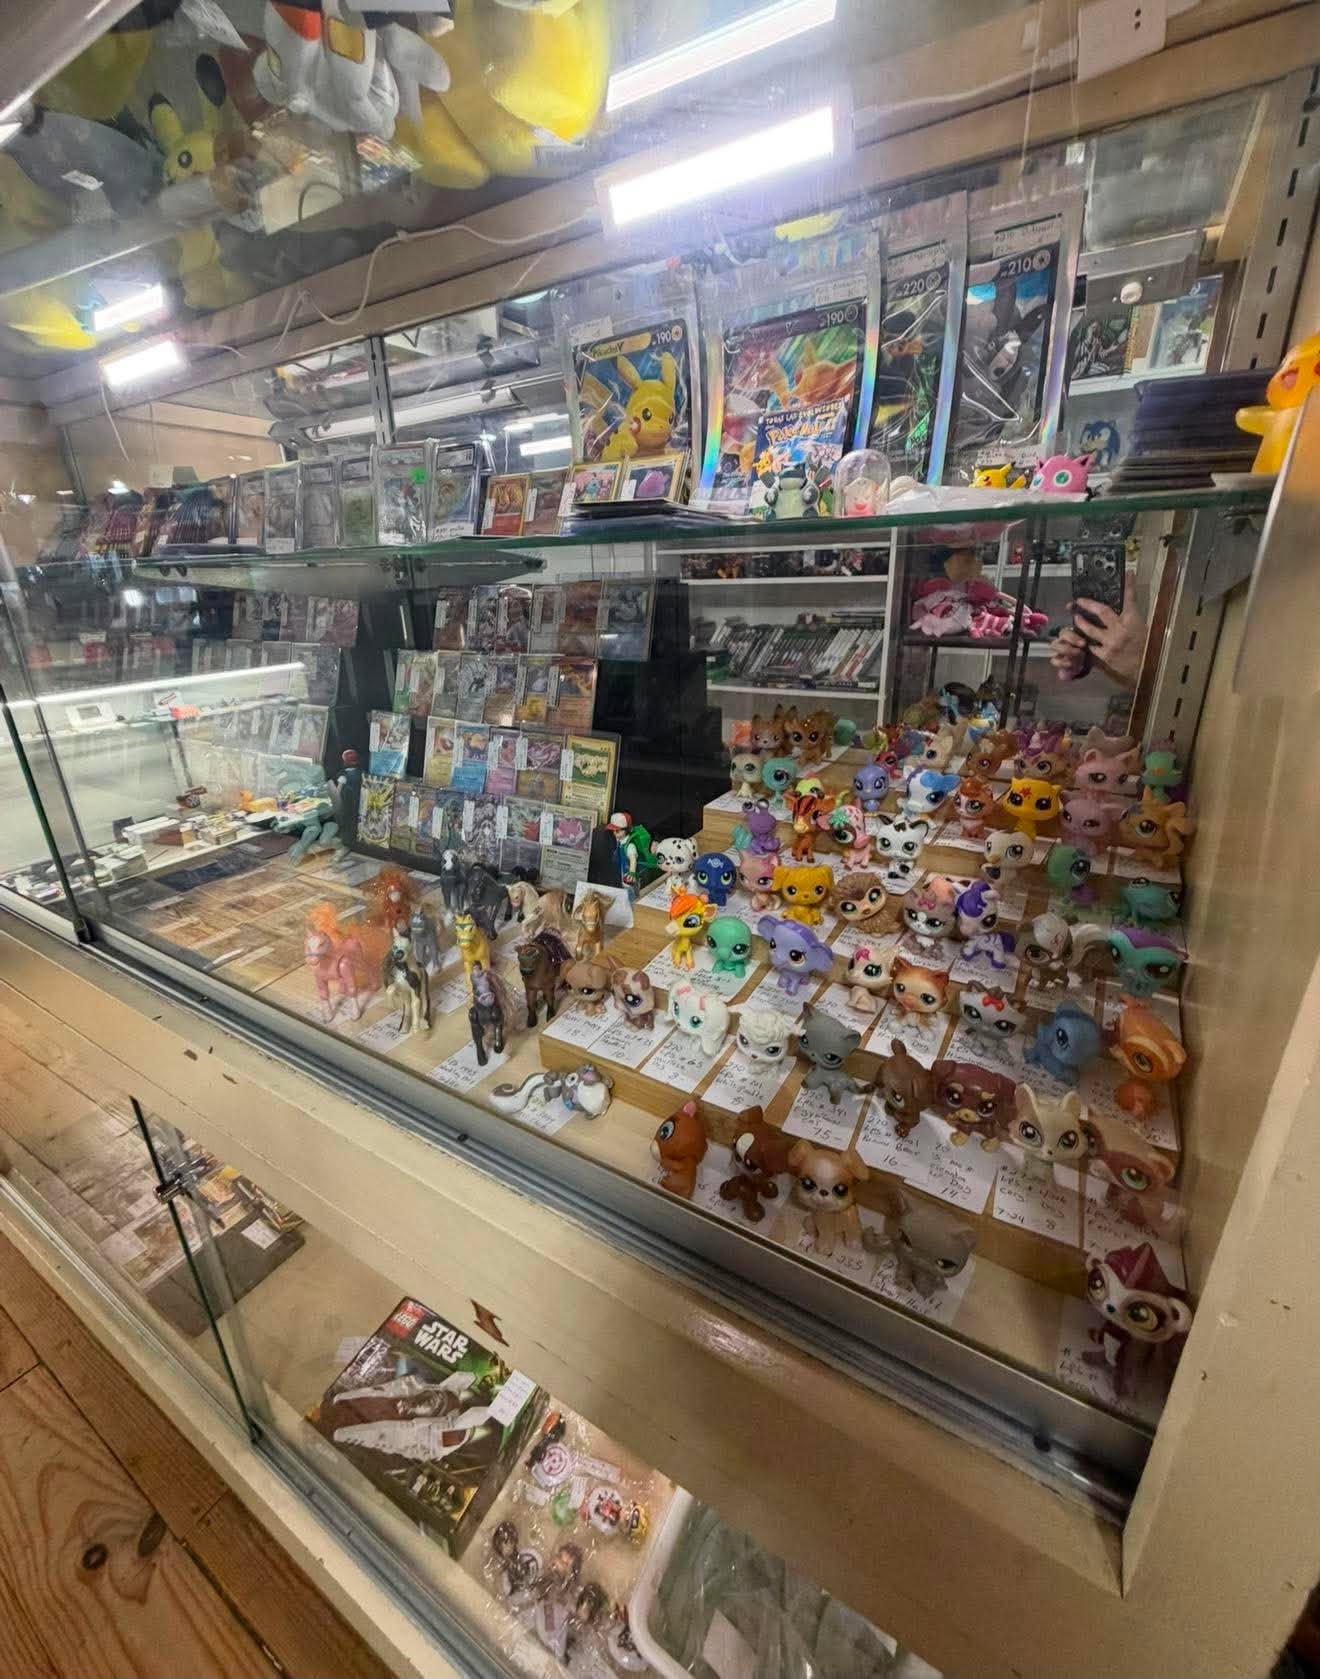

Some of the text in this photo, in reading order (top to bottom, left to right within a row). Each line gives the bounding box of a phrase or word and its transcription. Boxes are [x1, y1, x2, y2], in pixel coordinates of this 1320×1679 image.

[1009, 257, 1032, 275] 210
[903, 278, 925, 296] 220
[826, 310, 845, 327] 190
[656, 330, 672, 345] 190
[393, 1311, 417, 1329] LEGO
[423, 1321, 469, 1353] STAR
[414, 1330, 463, 1364] WARS
